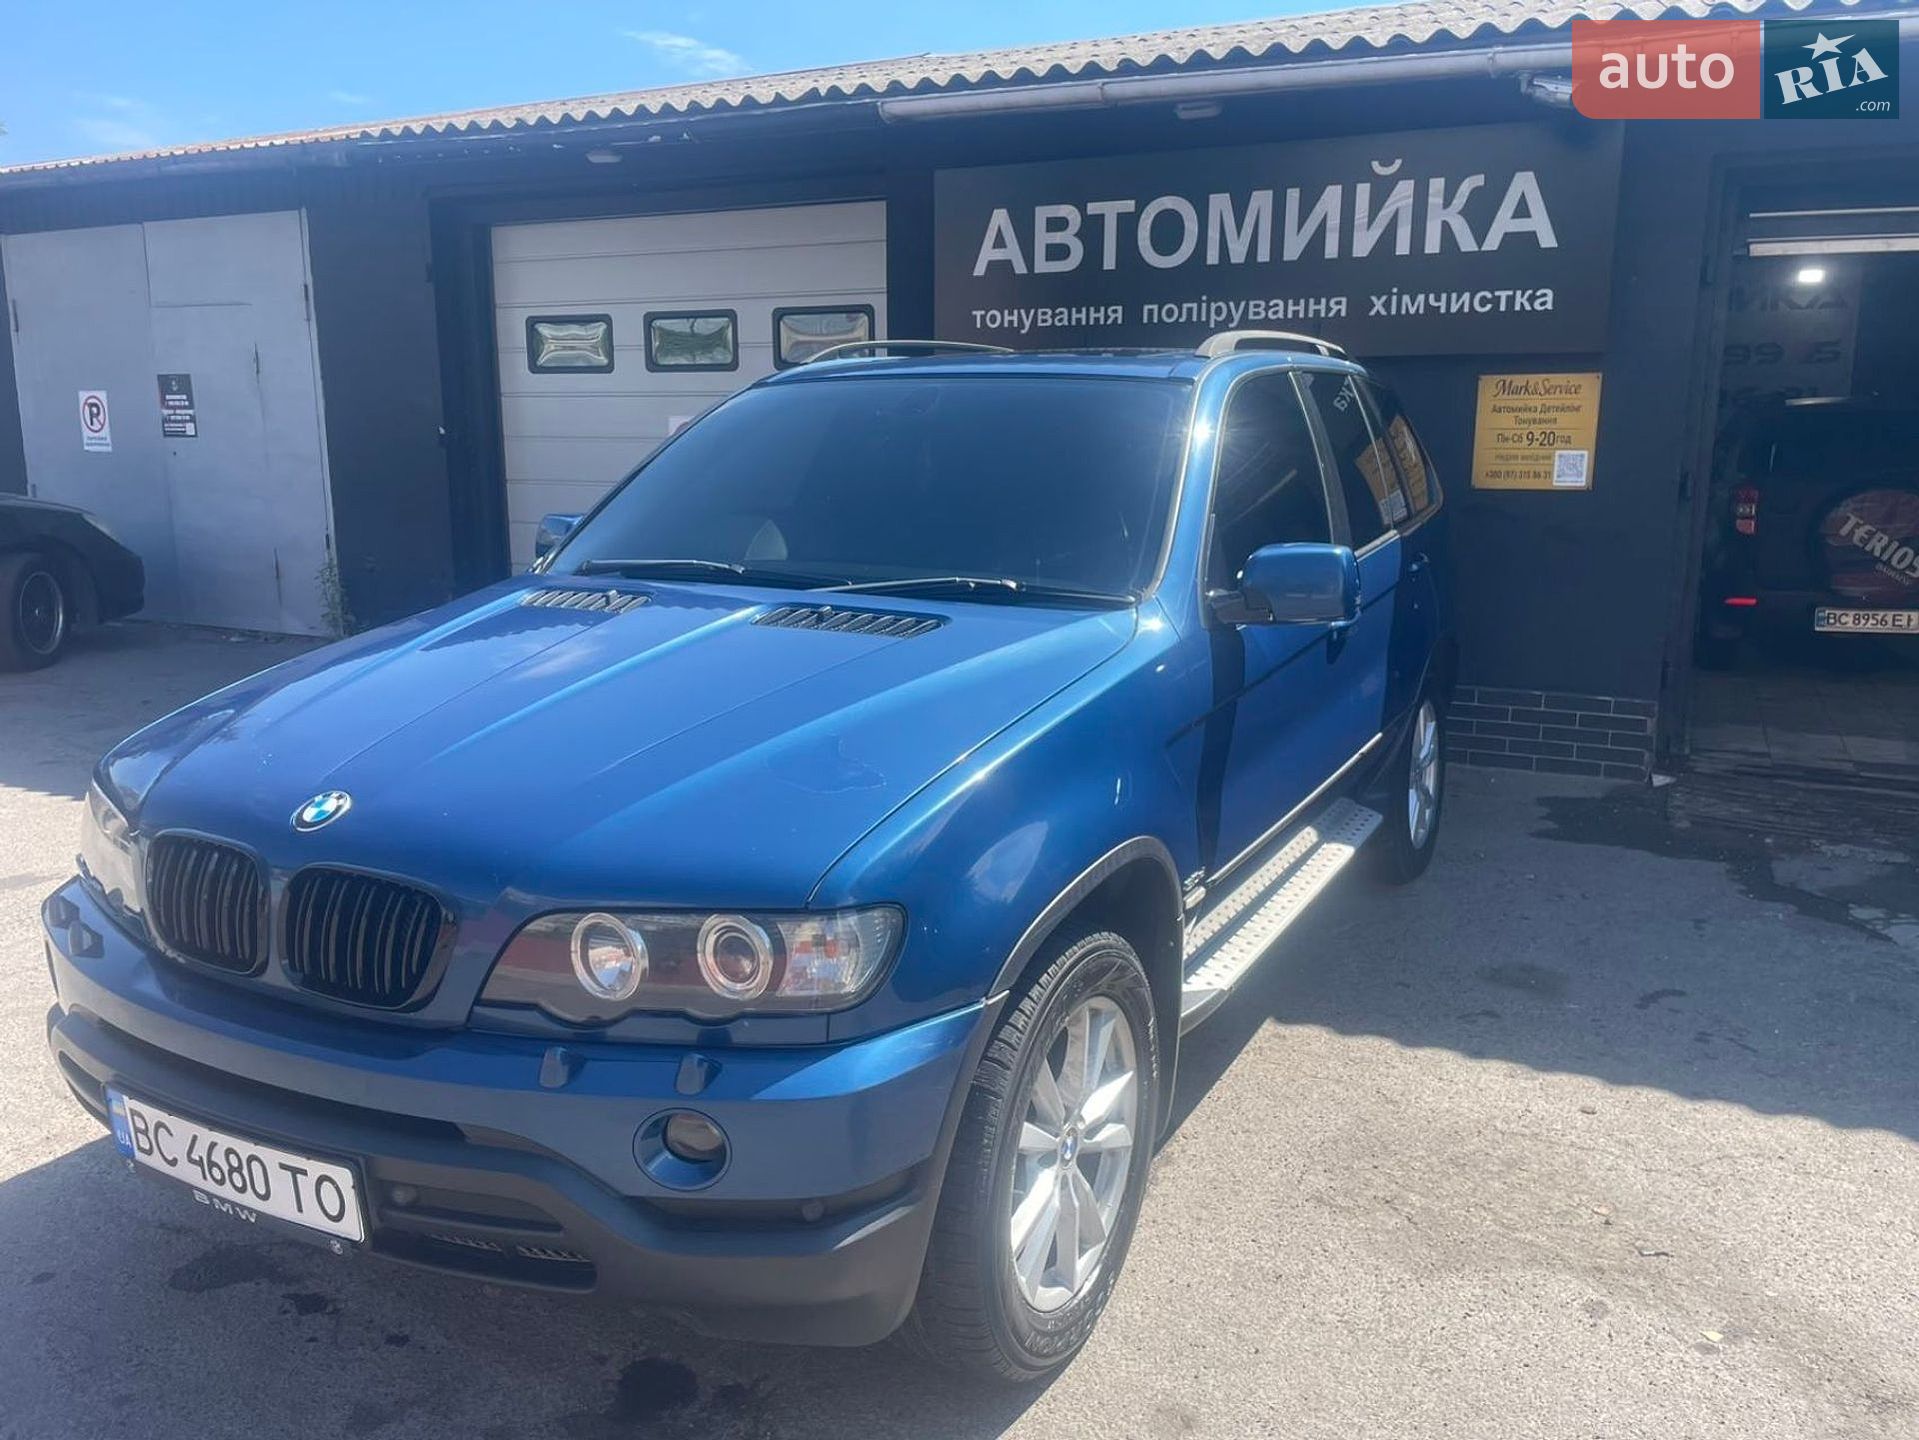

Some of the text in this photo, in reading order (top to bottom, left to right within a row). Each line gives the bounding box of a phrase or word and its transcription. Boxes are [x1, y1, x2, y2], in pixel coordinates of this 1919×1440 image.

[972, 158, 1559, 277] АВТОМИЙКА
[971, 287, 1555, 334] тонування полірування хімчистка
[1493, 378, 1583, 398] Mark&Service
[1491, 403, 1538, 414] Автомийка
[1513, 415, 1558, 426] Тонування
[1526, 431, 1556, 447] 9-20
[1826, 612, 1850, 626] BC
[1852, 612, 1888, 627] 8956
[127, 1106, 346, 1224] BC 4680 TO
[192, 1188, 258, 1224] BMW
